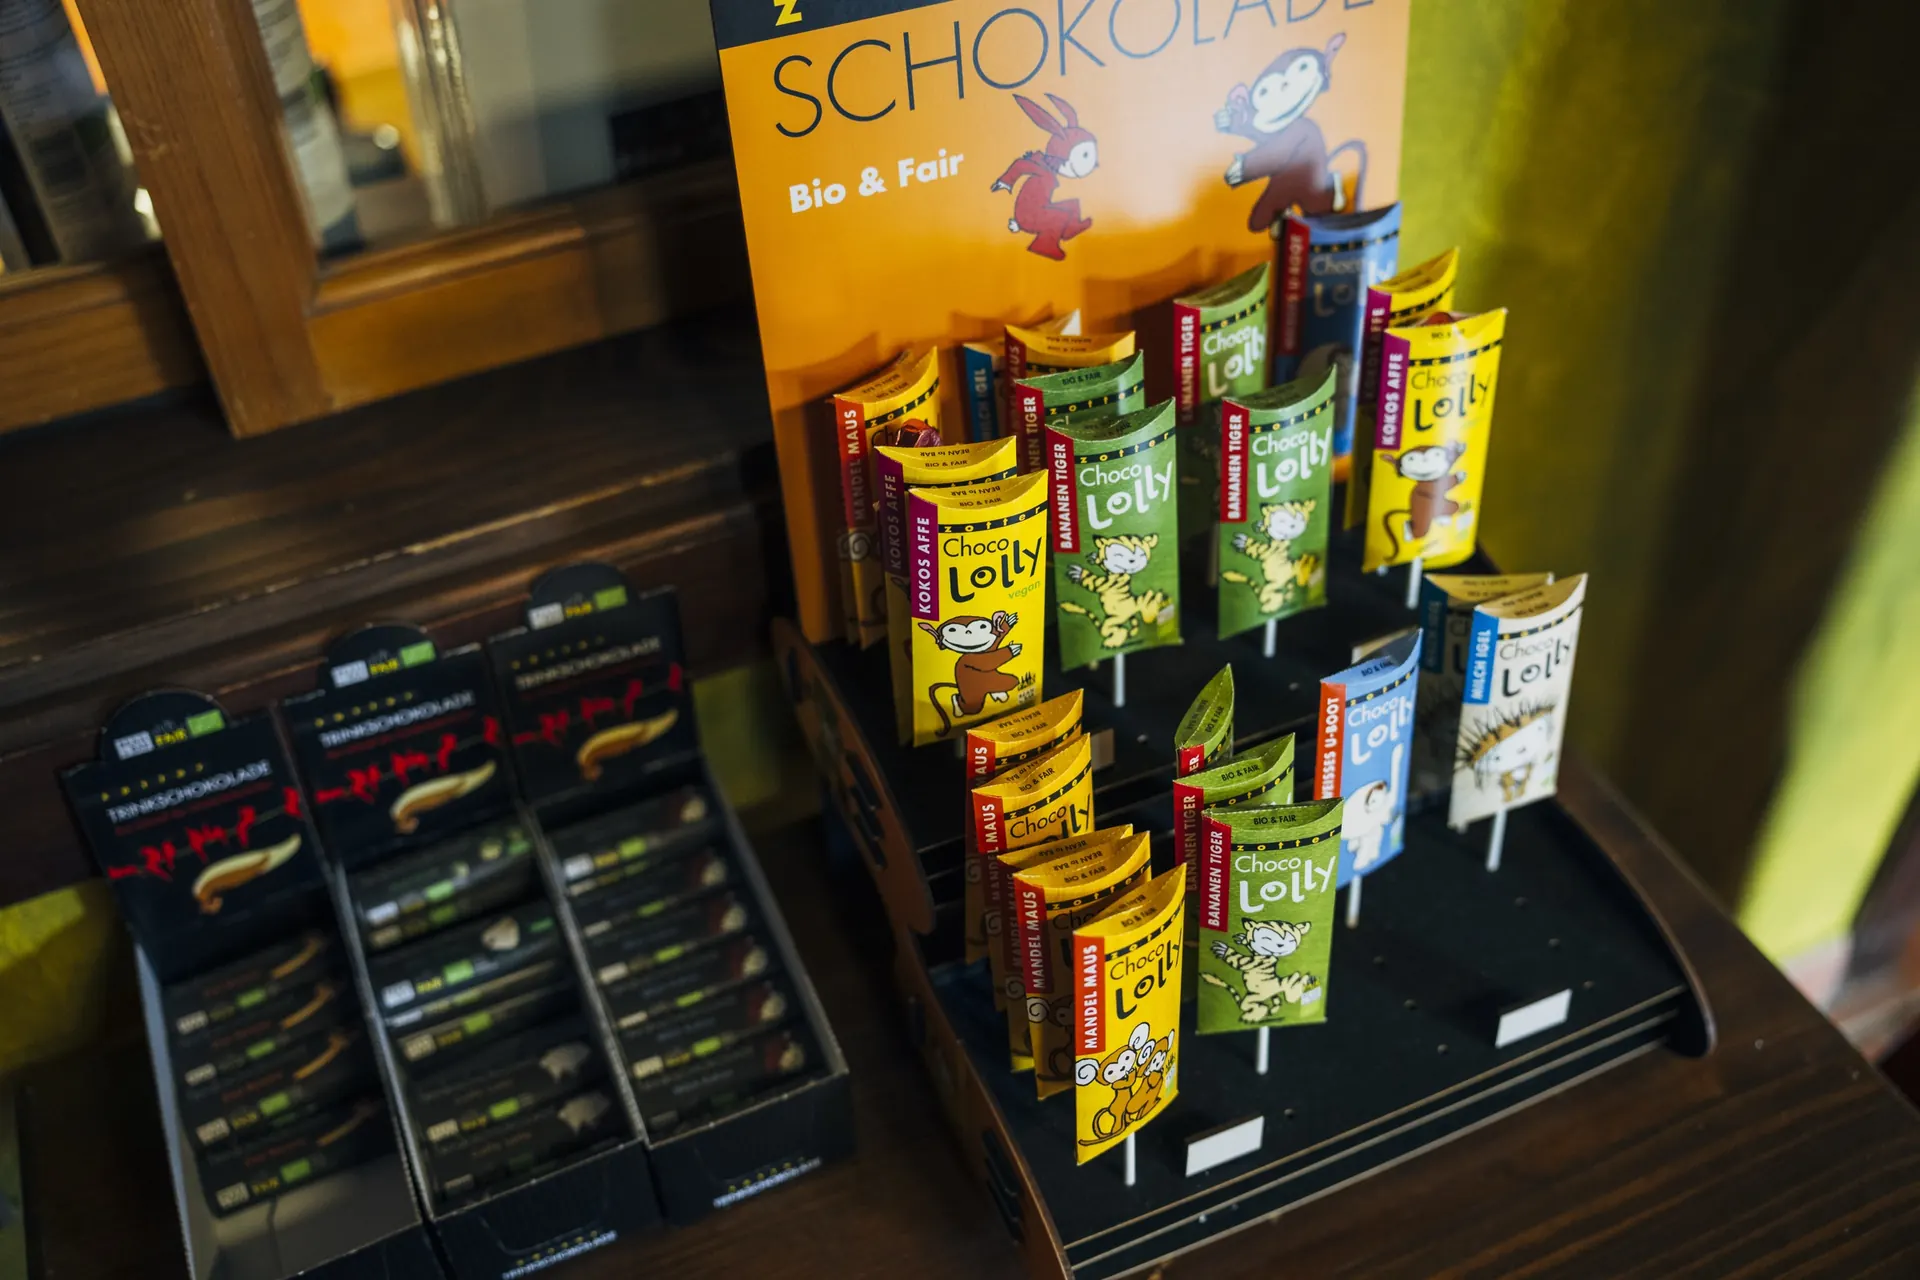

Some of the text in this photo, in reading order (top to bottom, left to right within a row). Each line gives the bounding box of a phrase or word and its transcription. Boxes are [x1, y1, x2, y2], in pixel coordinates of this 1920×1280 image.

[774, 0, 1374, 138] SCHOKOLA
[789, 147, 965, 214] Bio & Fair
[1180, 314, 1195, 354] TIGER
[1062, 376, 1076, 386] BIO
[1085, 370, 1102, 381] FAIR
[1381, 353, 1404, 446] KOKOS AFFE
[1414, 372, 1493, 432] Lolly
[844, 409, 860, 455] MAUS
[1023, 396, 1042, 473] ANEN TIGER
[1080, 432, 1170, 464] zotter
[1252, 431, 1309, 456] Choco
[948, 448, 970, 456] BEAN
[1053, 443, 1069, 481] TIGER
[1227, 414, 1243, 519] BANANEN TIGER
[1256, 426, 1333, 498] Lolly
[978, 485, 1001, 494] BEAN
[1079, 464, 1142, 487] Choco
[1085, 460, 1173, 530] Lolly
[944, 506, 1041, 533] zotter
[984, 497, 1003, 505] FAIR
[1056, 484, 1073, 549] BANANEN
[884, 474, 902, 570] KOKOS AFFE
[917, 517, 932, 614] KOKOS AFFE
[943, 535, 1009, 558] Choco
[949, 536, 1043, 603] Lolly
[1008, 579, 1041, 599] vegan
[1471, 629, 1491, 700] MILCH IGEL
[1010, 731, 1025, 739] BIO
[1032, 721, 1049, 732] FAIR
[1324, 697, 1340, 748] U-BOOT
[1347, 696, 1399, 728] Choco
[1351, 695, 1413, 766] Lolly
[107, 759, 273, 824] TRINKSCHOKOLADE
[1019, 783, 1033, 792] BIO
[1039, 767, 1056, 781] FAIR
[1221, 764, 1261, 782] BIO & FAIR
[1009, 768, 1089, 819] zotter
[1183, 794, 1196, 830] TIGER
[981, 803, 998, 843] MAUS
[1010, 805, 1067, 839] Choco
[1254, 814, 1297, 825] BIO & FAIR
[1080, 850, 1103, 862] BEAN
[1236, 830, 1336, 852] zotter
[1053, 863, 1069, 872] BAR
[1064, 875, 1080, 883] BIO
[1089, 865, 1108, 876] FAIR
[1208, 831, 1223, 927] BANANEN TIGER
[1235, 853, 1302, 873] Choco
[1053, 867, 1146, 910] zotter
[1239, 855, 1336, 914] Lolly
[1052, 907, 1096, 931] Cho
[1121, 918, 1134, 928] BIO
[1141, 906, 1158, 918] FAIR
[1023, 891, 1046, 989] MANDEL MAUS
[1110, 943, 1165, 981] Choco
[1115, 927, 1183, 1020] Lolly
[1083, 944, 1098, 1049] MANDEL MAUS
